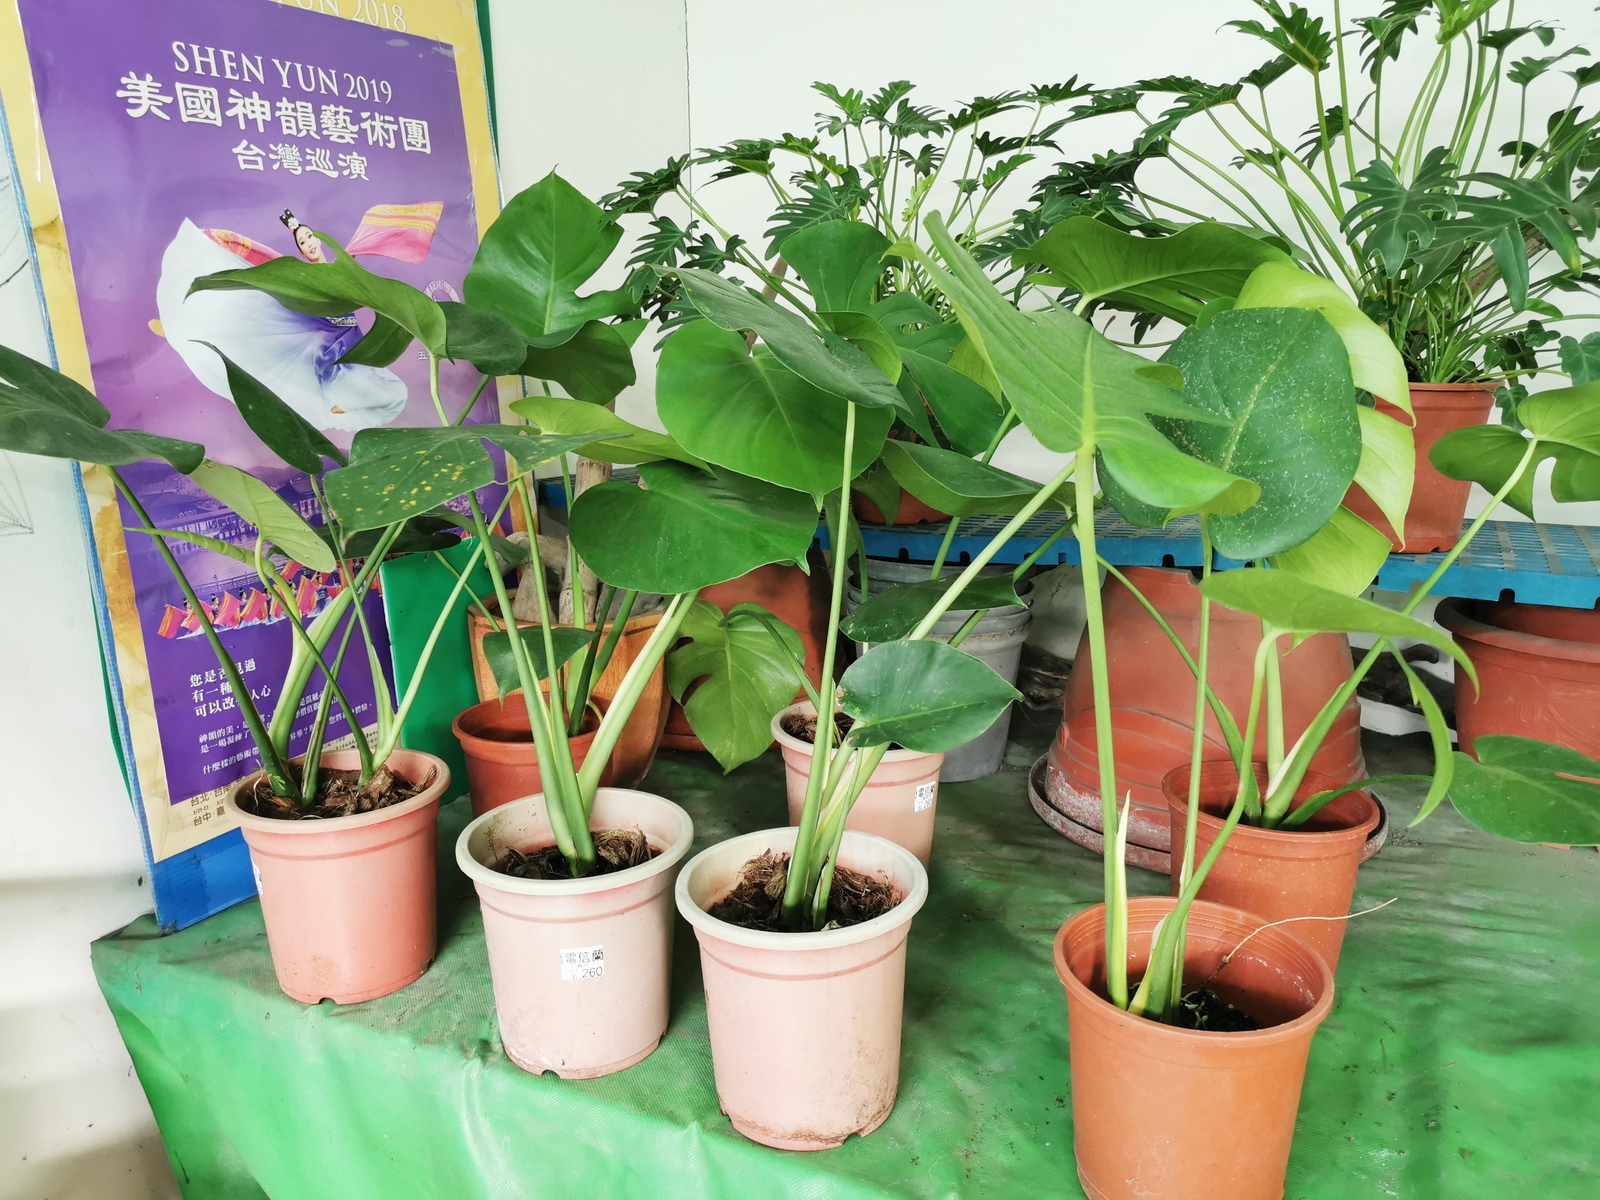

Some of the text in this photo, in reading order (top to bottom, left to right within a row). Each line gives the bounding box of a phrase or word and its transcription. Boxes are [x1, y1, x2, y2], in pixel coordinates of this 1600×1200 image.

[352, 0, 407, 33] 2018
[171, 41, 392, 105] SHEN YUN 2019
[115, 70, 432, 155] 美國神韻藝術團
[232, 139, 370, 181] 台灣巡演
[194, 685, 272, 717] 可以改人心
[582, 966, 603, 978] 260
